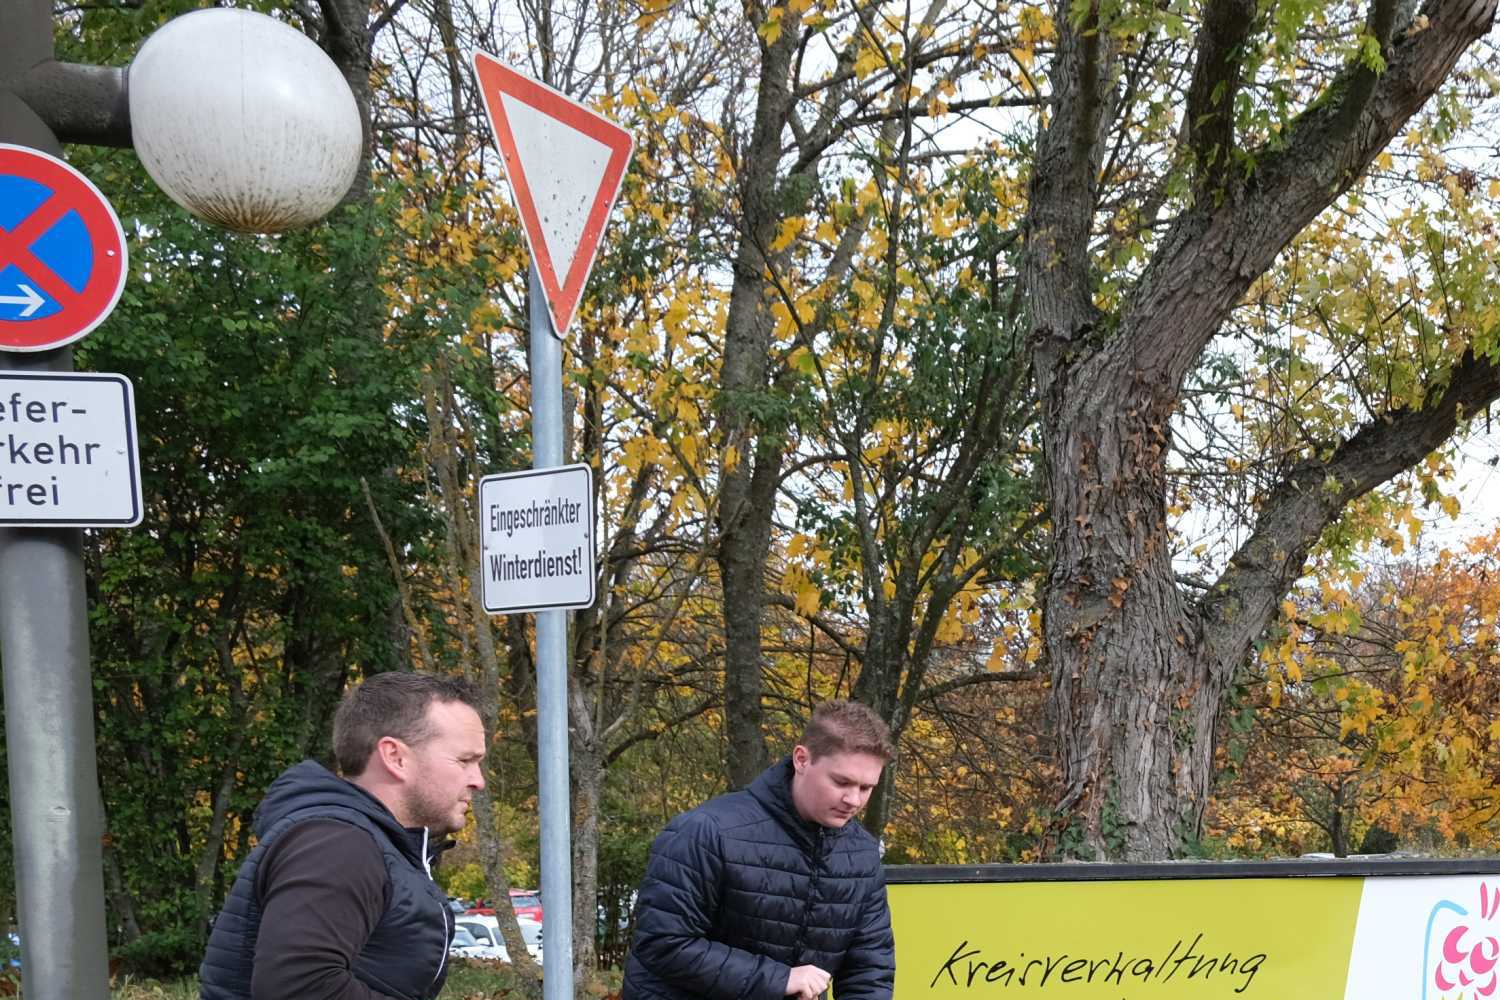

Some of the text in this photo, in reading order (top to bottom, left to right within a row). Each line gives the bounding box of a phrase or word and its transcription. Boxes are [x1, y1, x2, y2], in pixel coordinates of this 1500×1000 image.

[0, 392, 87, 423] fer-
[0, 475, 59, 506] rei
[490, 497, 581, 538] Eingeschränkter
[490, 546, 582, 582] Winterdienst!
[930, 933, 1268, 994] Kreisverwaltung
